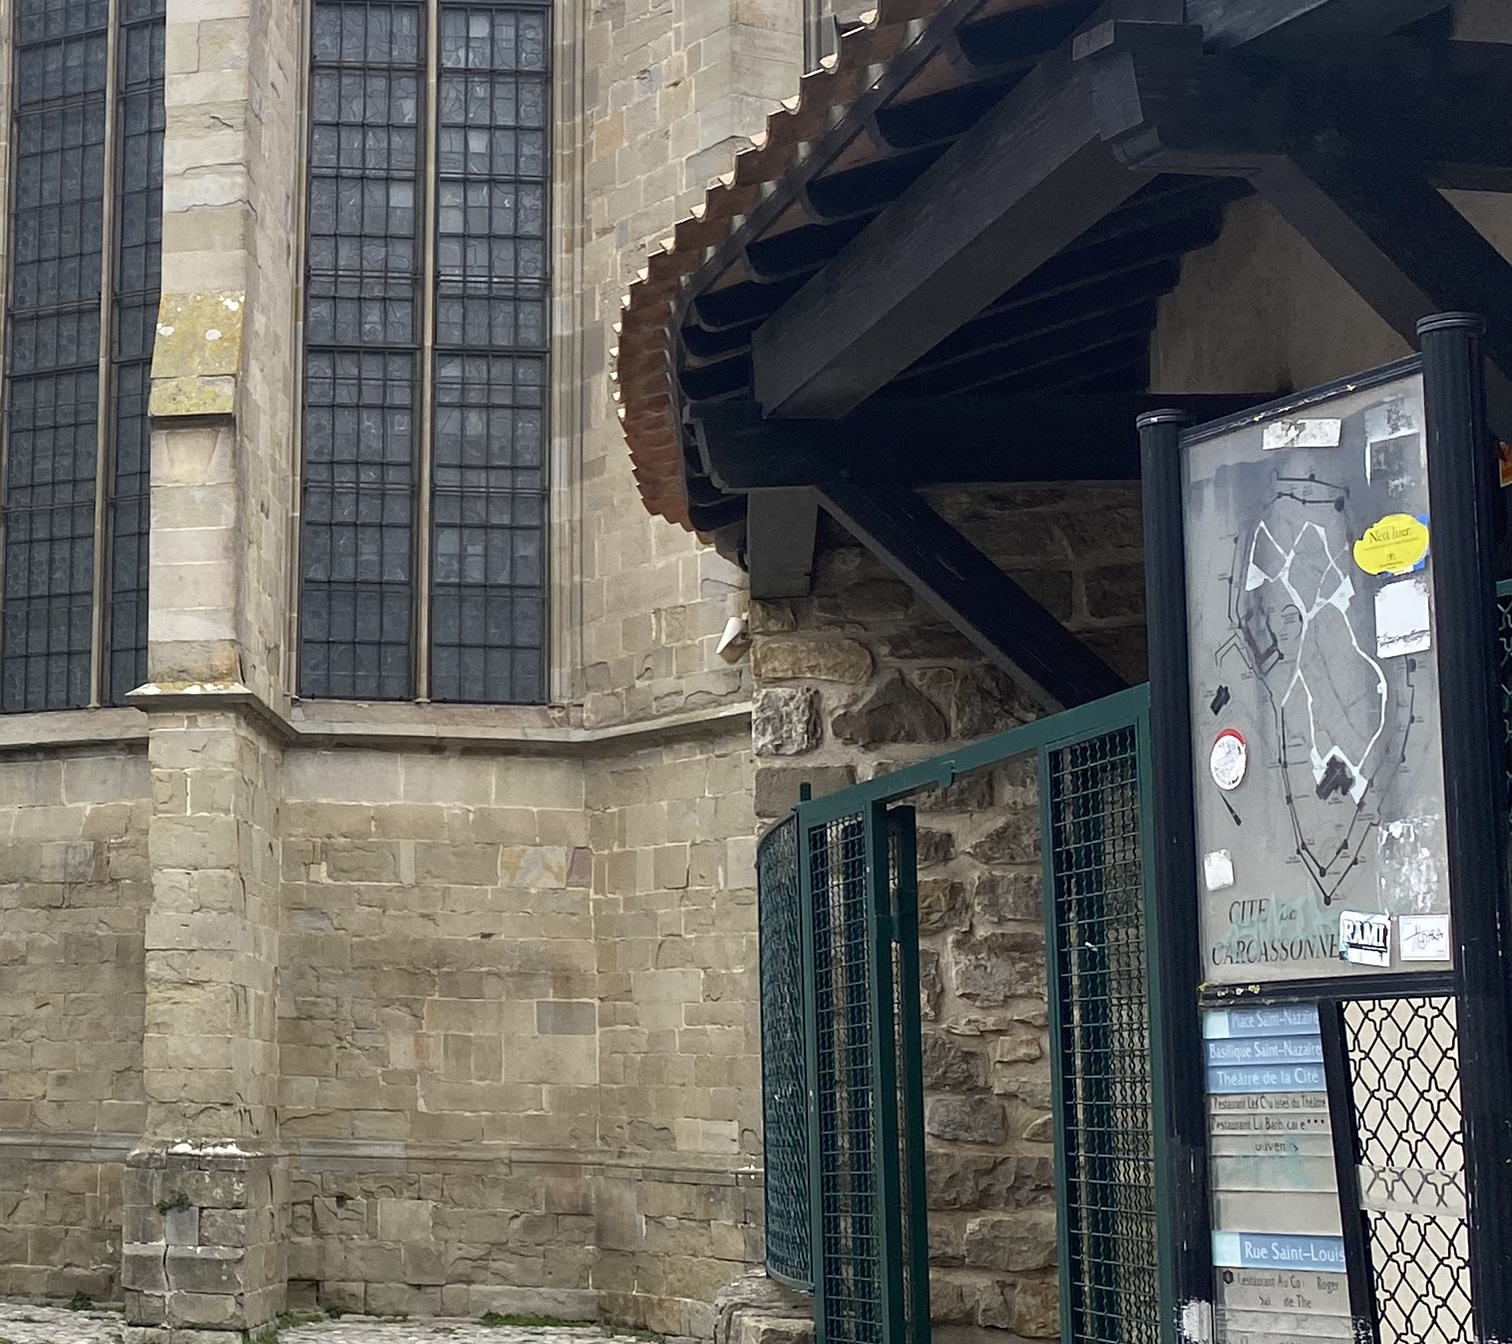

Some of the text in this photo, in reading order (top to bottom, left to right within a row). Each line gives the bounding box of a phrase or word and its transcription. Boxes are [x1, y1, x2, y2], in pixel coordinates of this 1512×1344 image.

[1229, 898, 1269, 923] CITE
[1212, 934, 1340, 966] CARCASSONNE
[1232, 1010, 1319, 1028] Place Saint-Nazaire
[1209, 1041, 1322, 1062] Basilique Saint-Nazaire
[1262, 1072, 1277, 1084] de
[1281, 1071, 1291, 1084] la
[1294, 1067, 1319, 1084] Cité
[1244, 1241, 1345, 1262] Rue Saint-Louis
